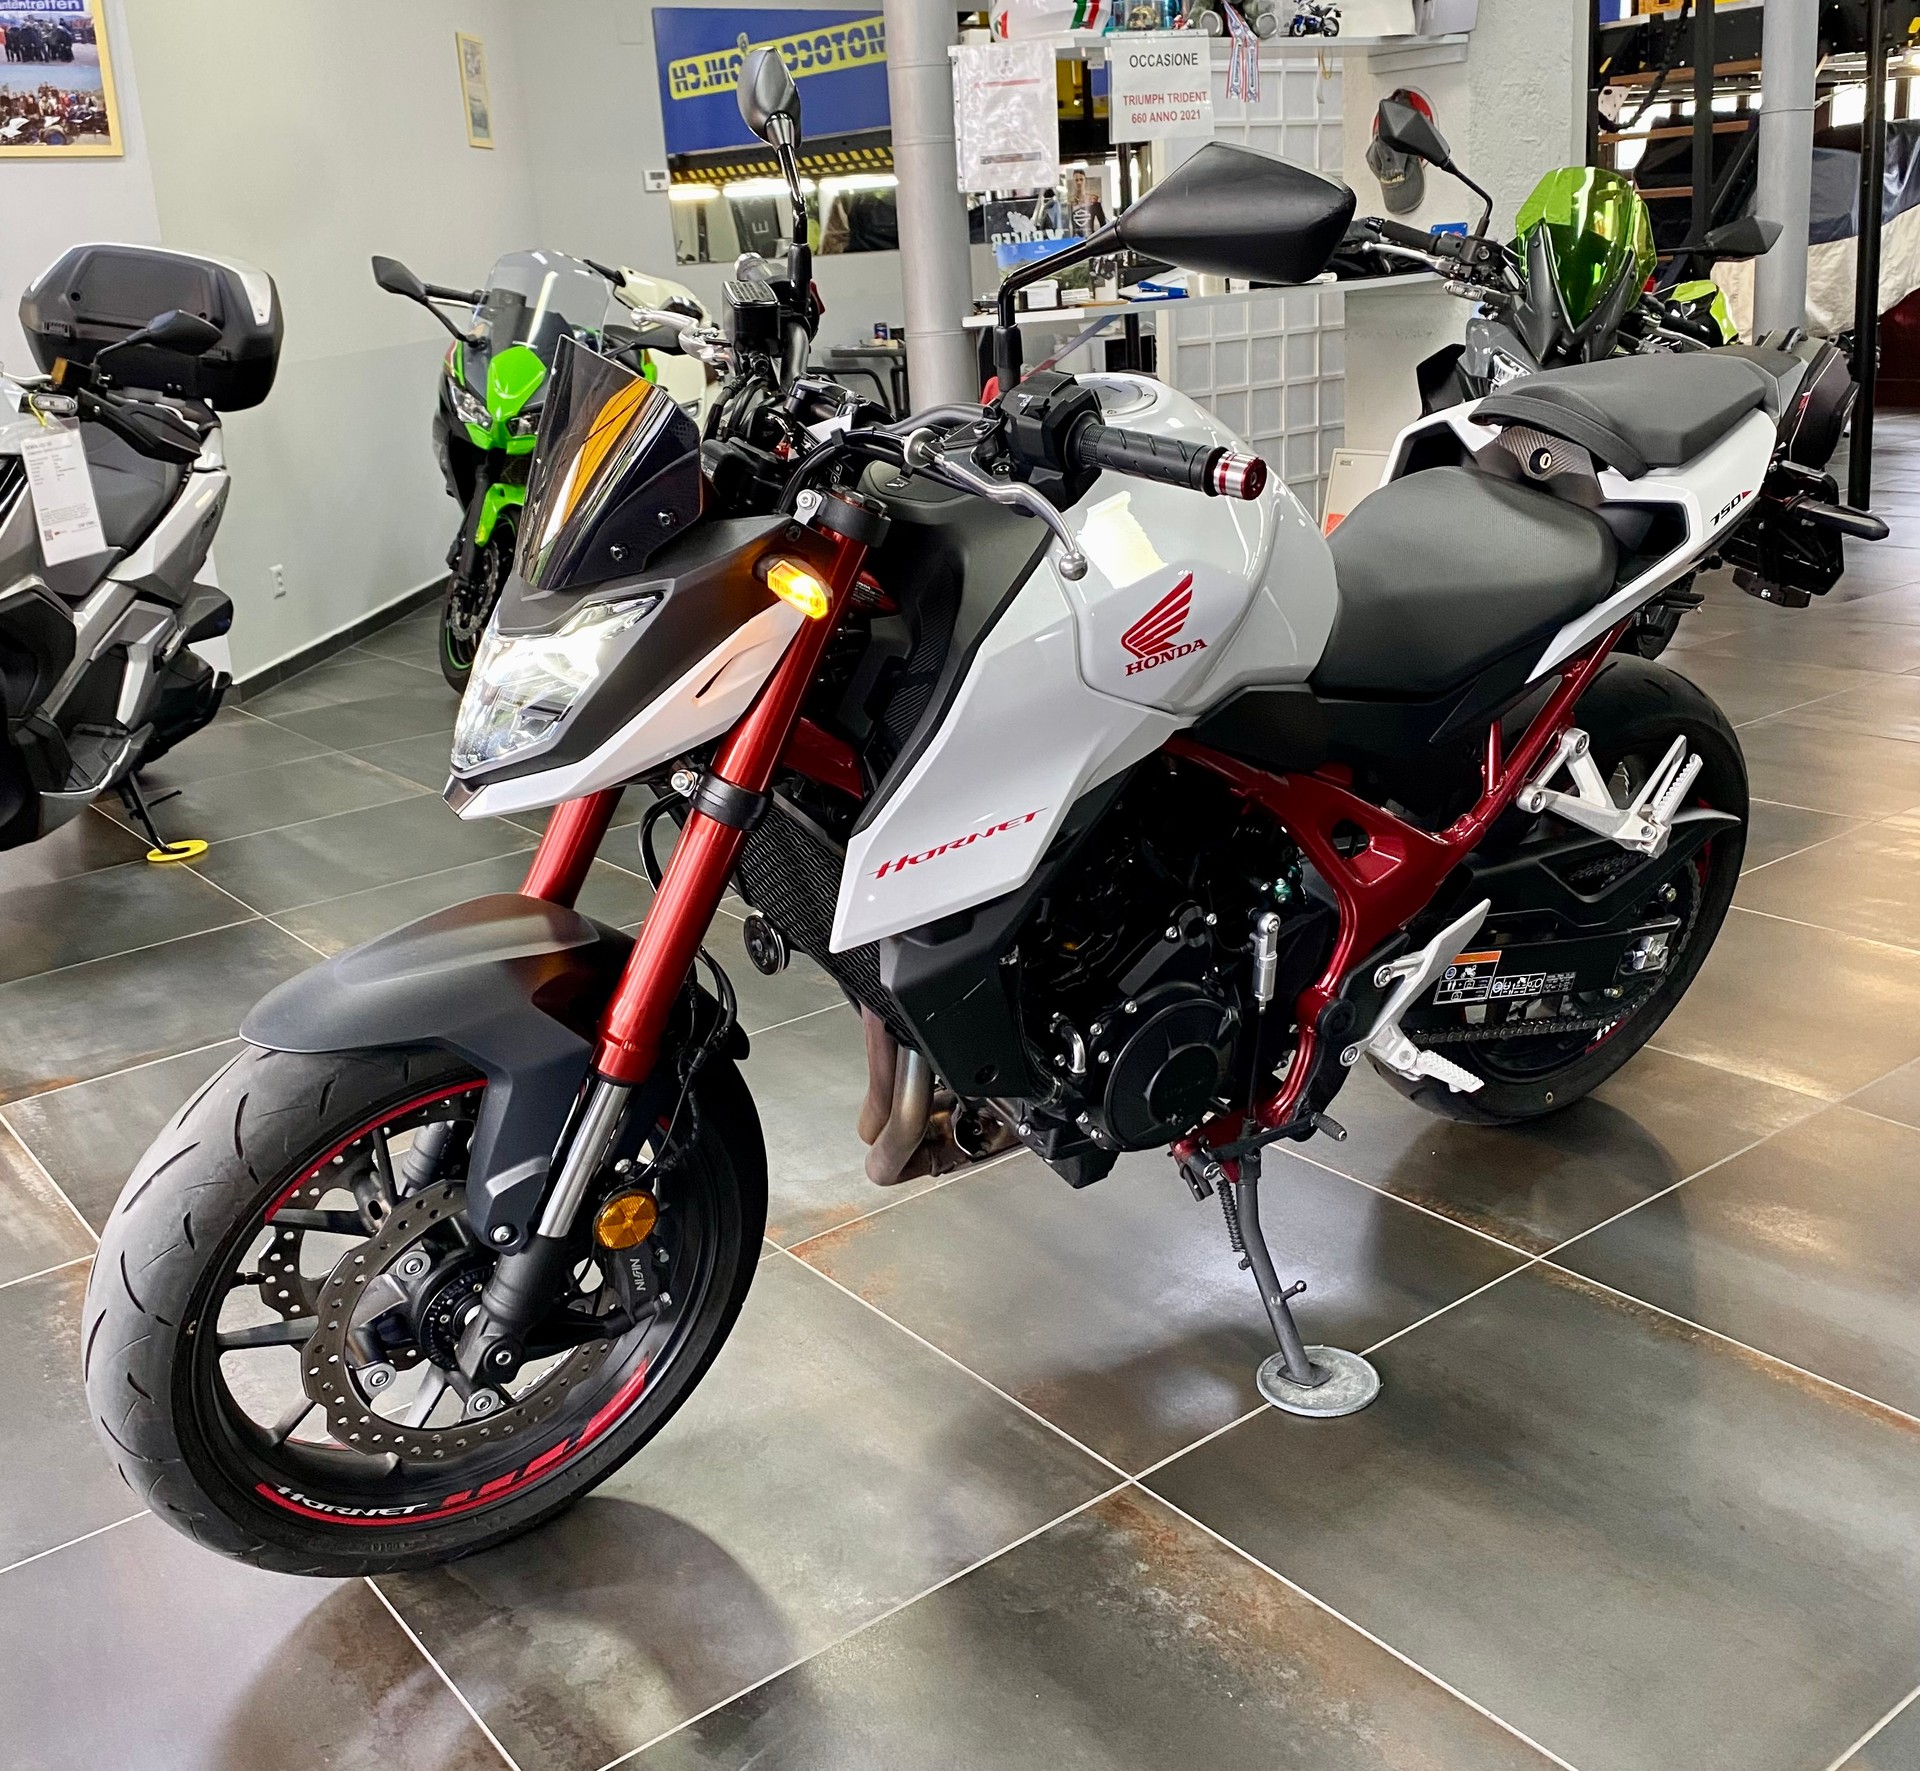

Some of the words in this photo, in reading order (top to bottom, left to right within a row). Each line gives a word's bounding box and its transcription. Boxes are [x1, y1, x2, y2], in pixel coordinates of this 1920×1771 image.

[1129, 53, 1199, 67] OCCASIONE
[1123, 93, 1165, 106] TRIUMPH
[1168, 91, 1207, 104] TRIDENT
[1131, 112, 1147, 123] 660
[1149, 111, 1178, 122] ANNO
[1180, 109, 1201, 121] 2021
[1710, 494, 1742, 526] 750
[1125, 638, 1208, 676] HONDA
[866, 807, 1048, 879] HORNET
[274, 1482, 428, 1517] HORNET
